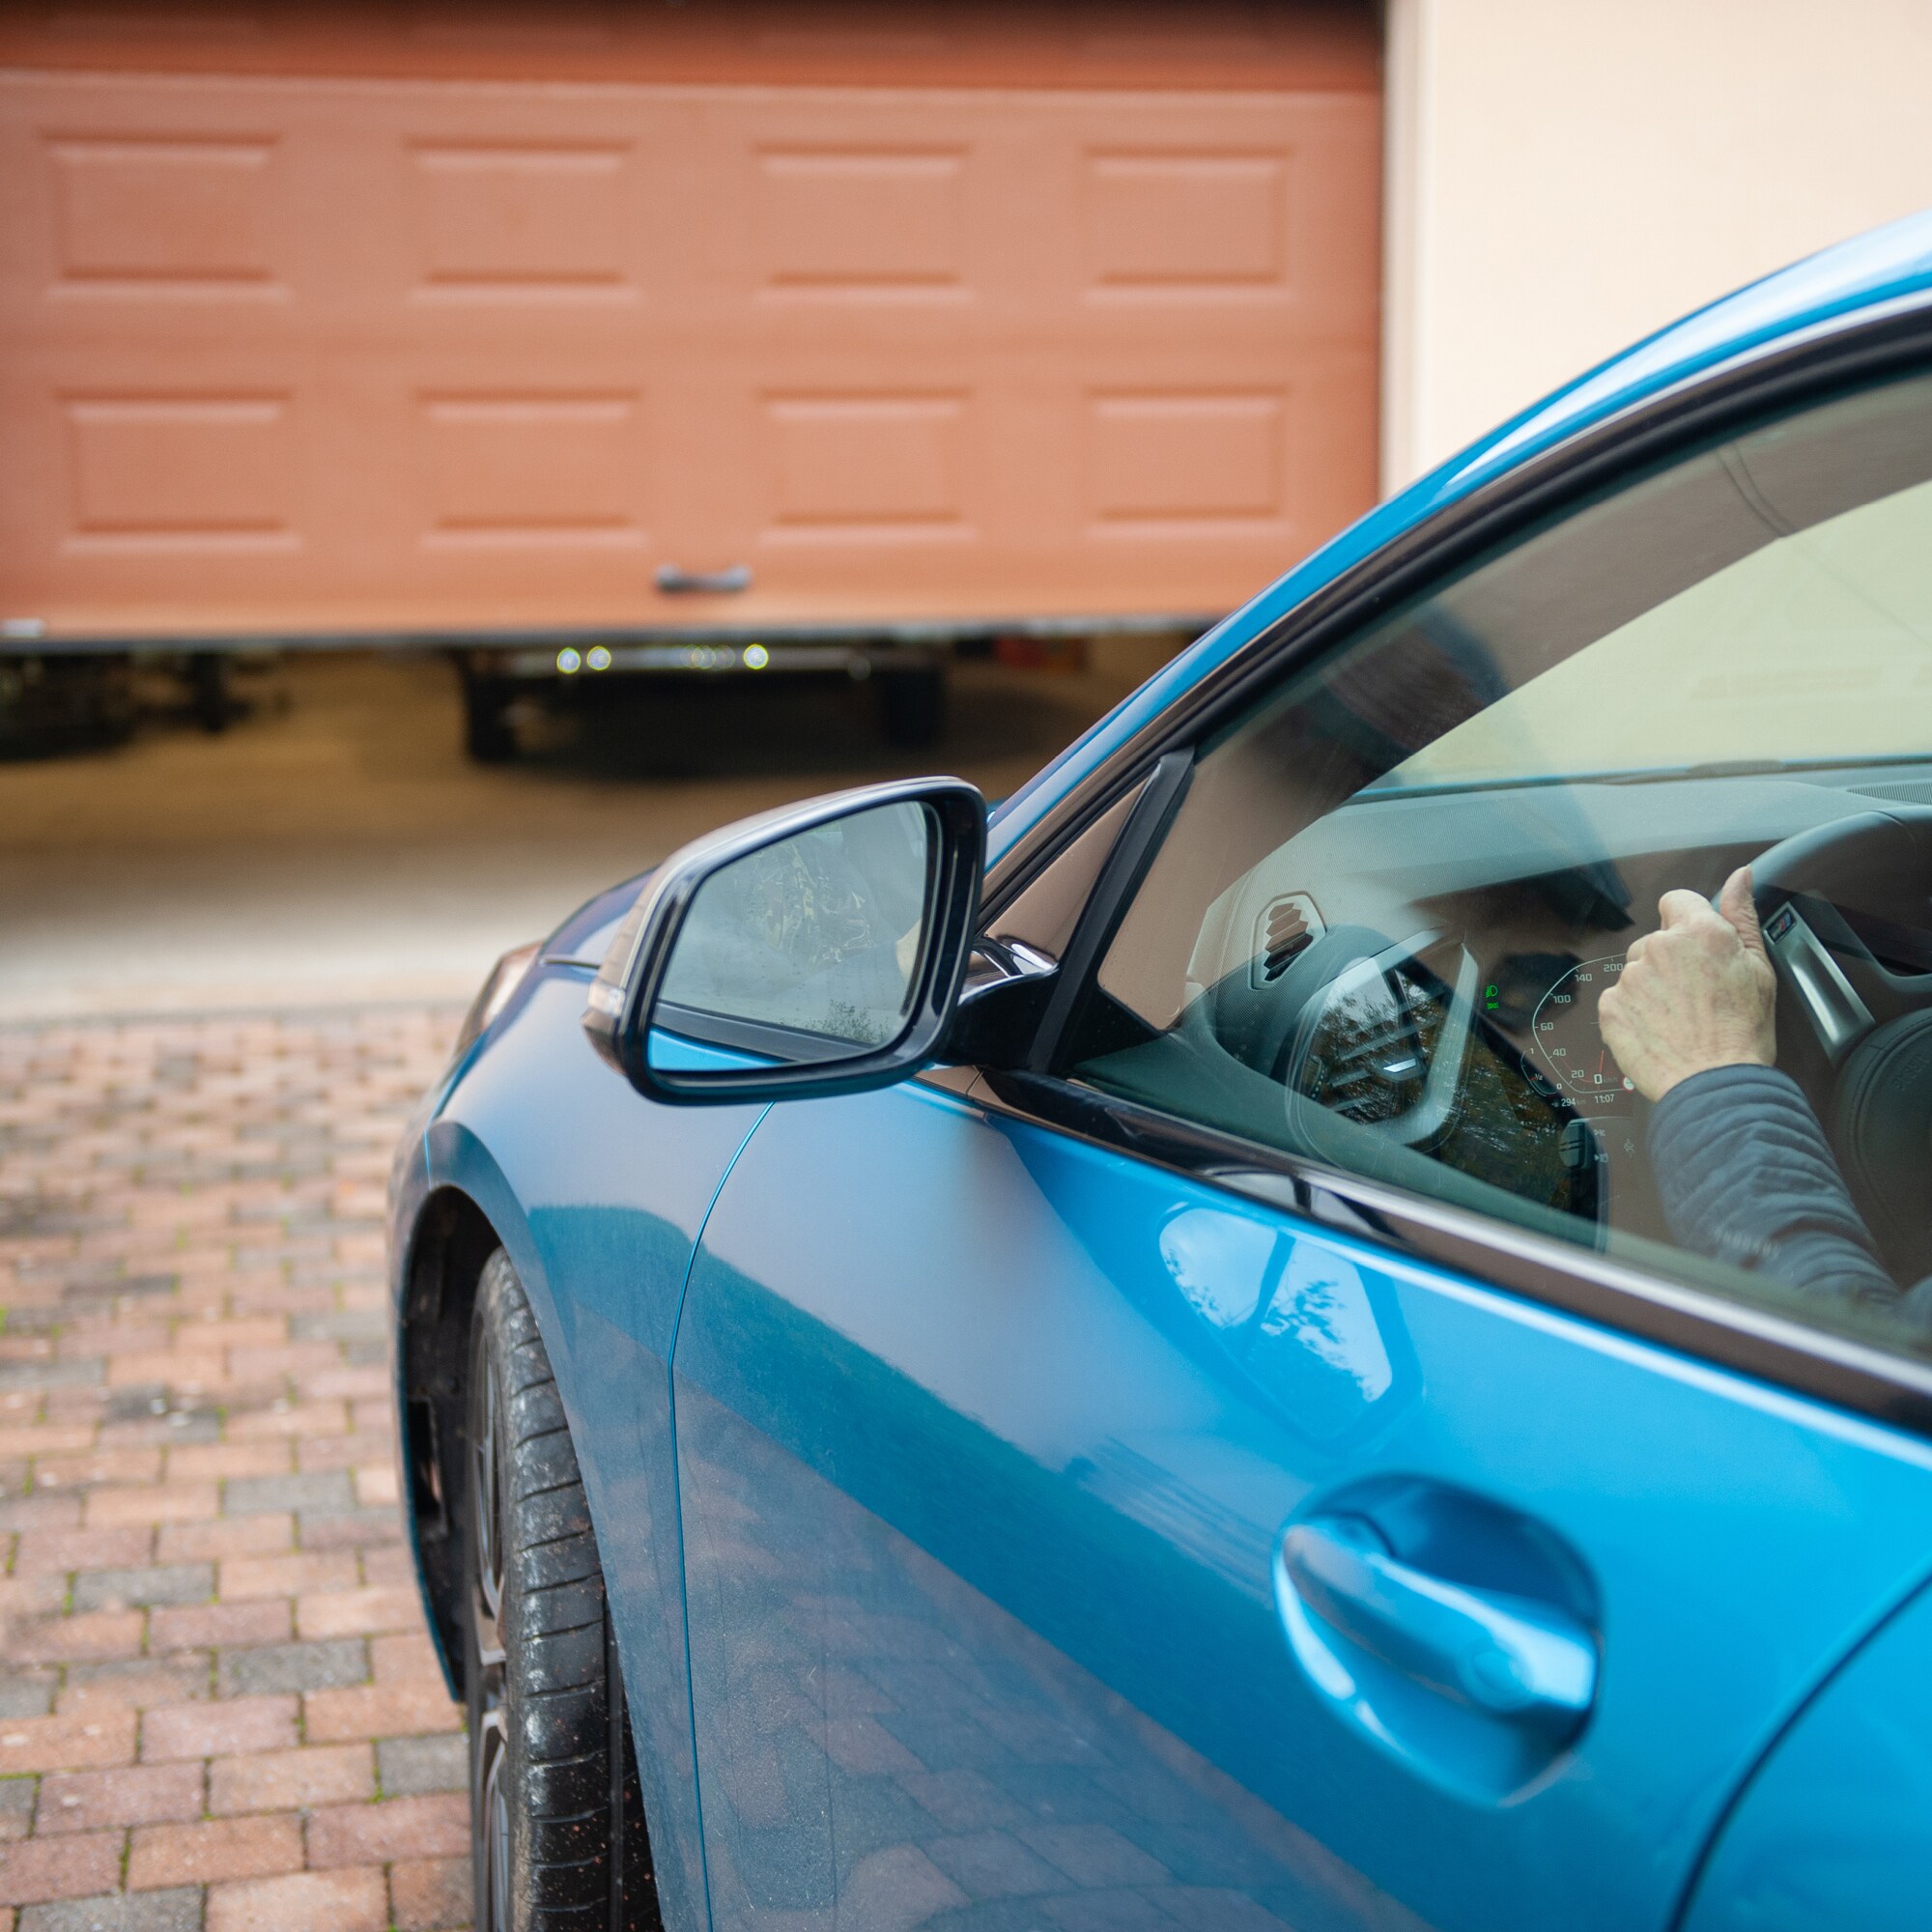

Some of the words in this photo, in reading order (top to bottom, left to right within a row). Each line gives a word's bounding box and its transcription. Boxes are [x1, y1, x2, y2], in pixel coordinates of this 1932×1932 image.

[1604, 963, 1624, 972] 200
[1575, 974, 1593, 982] 140
[1552, 994, 1572, 1004] 100
[1540, 1022, 1554, 1031] 60
[1552, 1048, 1567, 1057] 40
[1571, 1069, 1584, 1078] 20
[1594, 1073, 1604, 1085] 0
[1561, 1097, 1577, 1107] 294
[1594, 1094, 1615, 1104] 11:07
